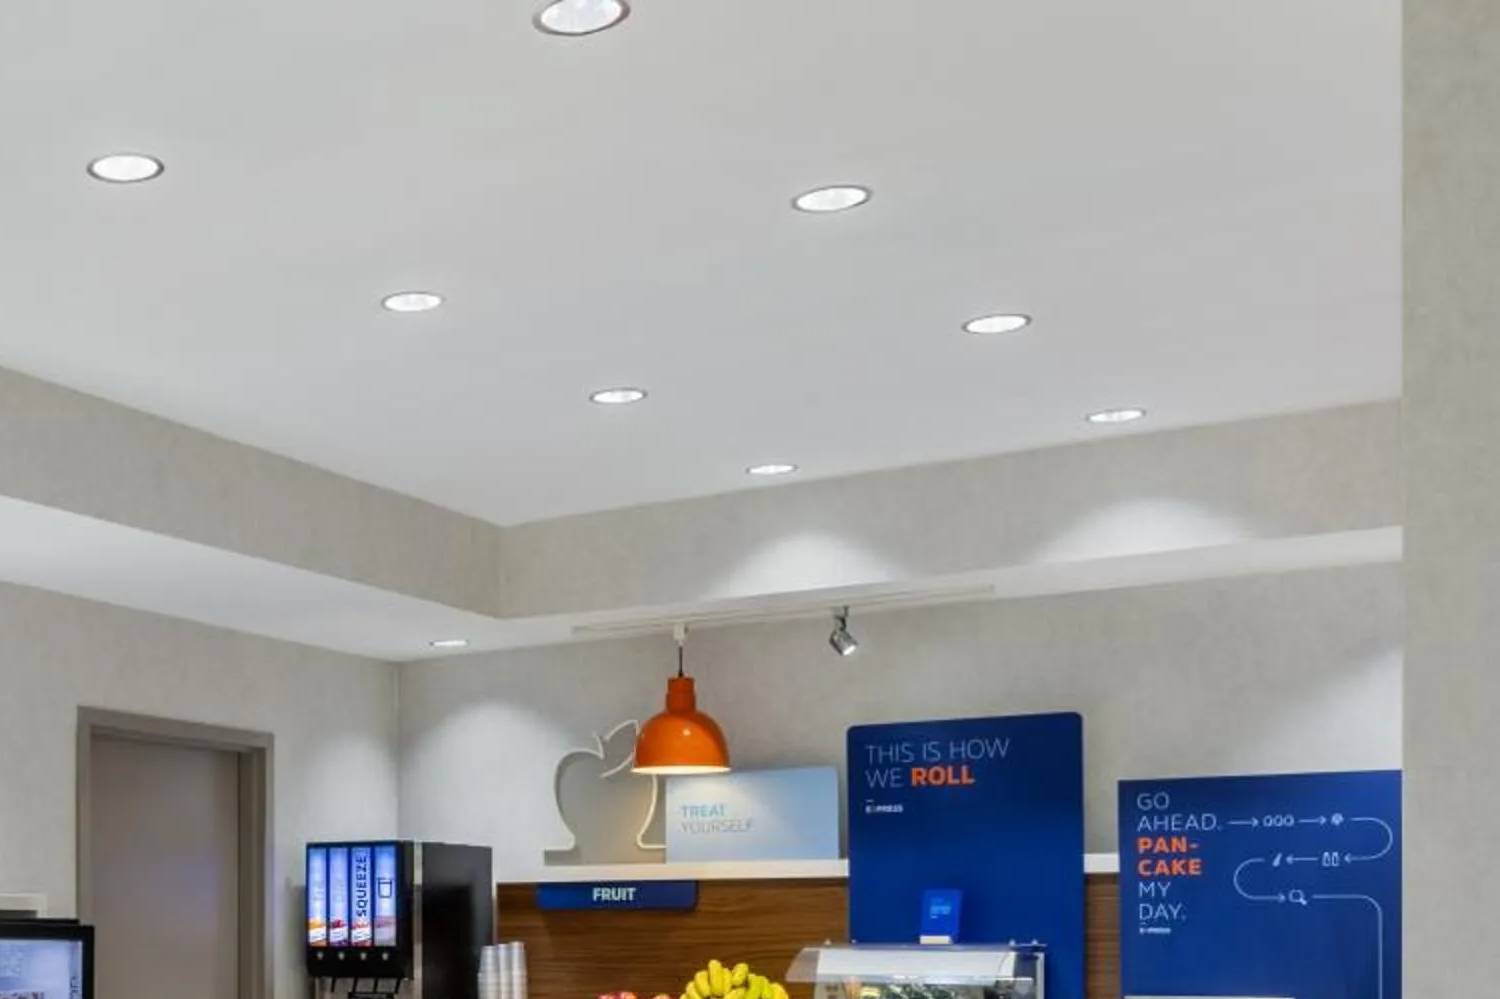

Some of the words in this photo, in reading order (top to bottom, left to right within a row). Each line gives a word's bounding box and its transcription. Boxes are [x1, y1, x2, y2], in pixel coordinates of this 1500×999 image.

[864, 742, 915, 765] THIS
[922, 741, 941, 762] IS
[949, 737, 1010, 760] HOW
[864, 767, 904, 789] WE
[911, 765, 975, 787] ROLL
[680, 803, 726, 818] TREAT
[1136, 792, 1170, 811] GO
[680, 817, 753, 834] YOURSELF
[1136, 813, 1222, 832] AHEAD.
[1137, 836, 1199, 854] PAN-
[1137, 858, 1202, 876] CAKE
[356, 854, 369, 917] SQUEEZE
[592, 887, 636, 902] FRUIT
[1138, 881, 1171, 897] MY
[1139, 902, 1186, 920] DAY.
